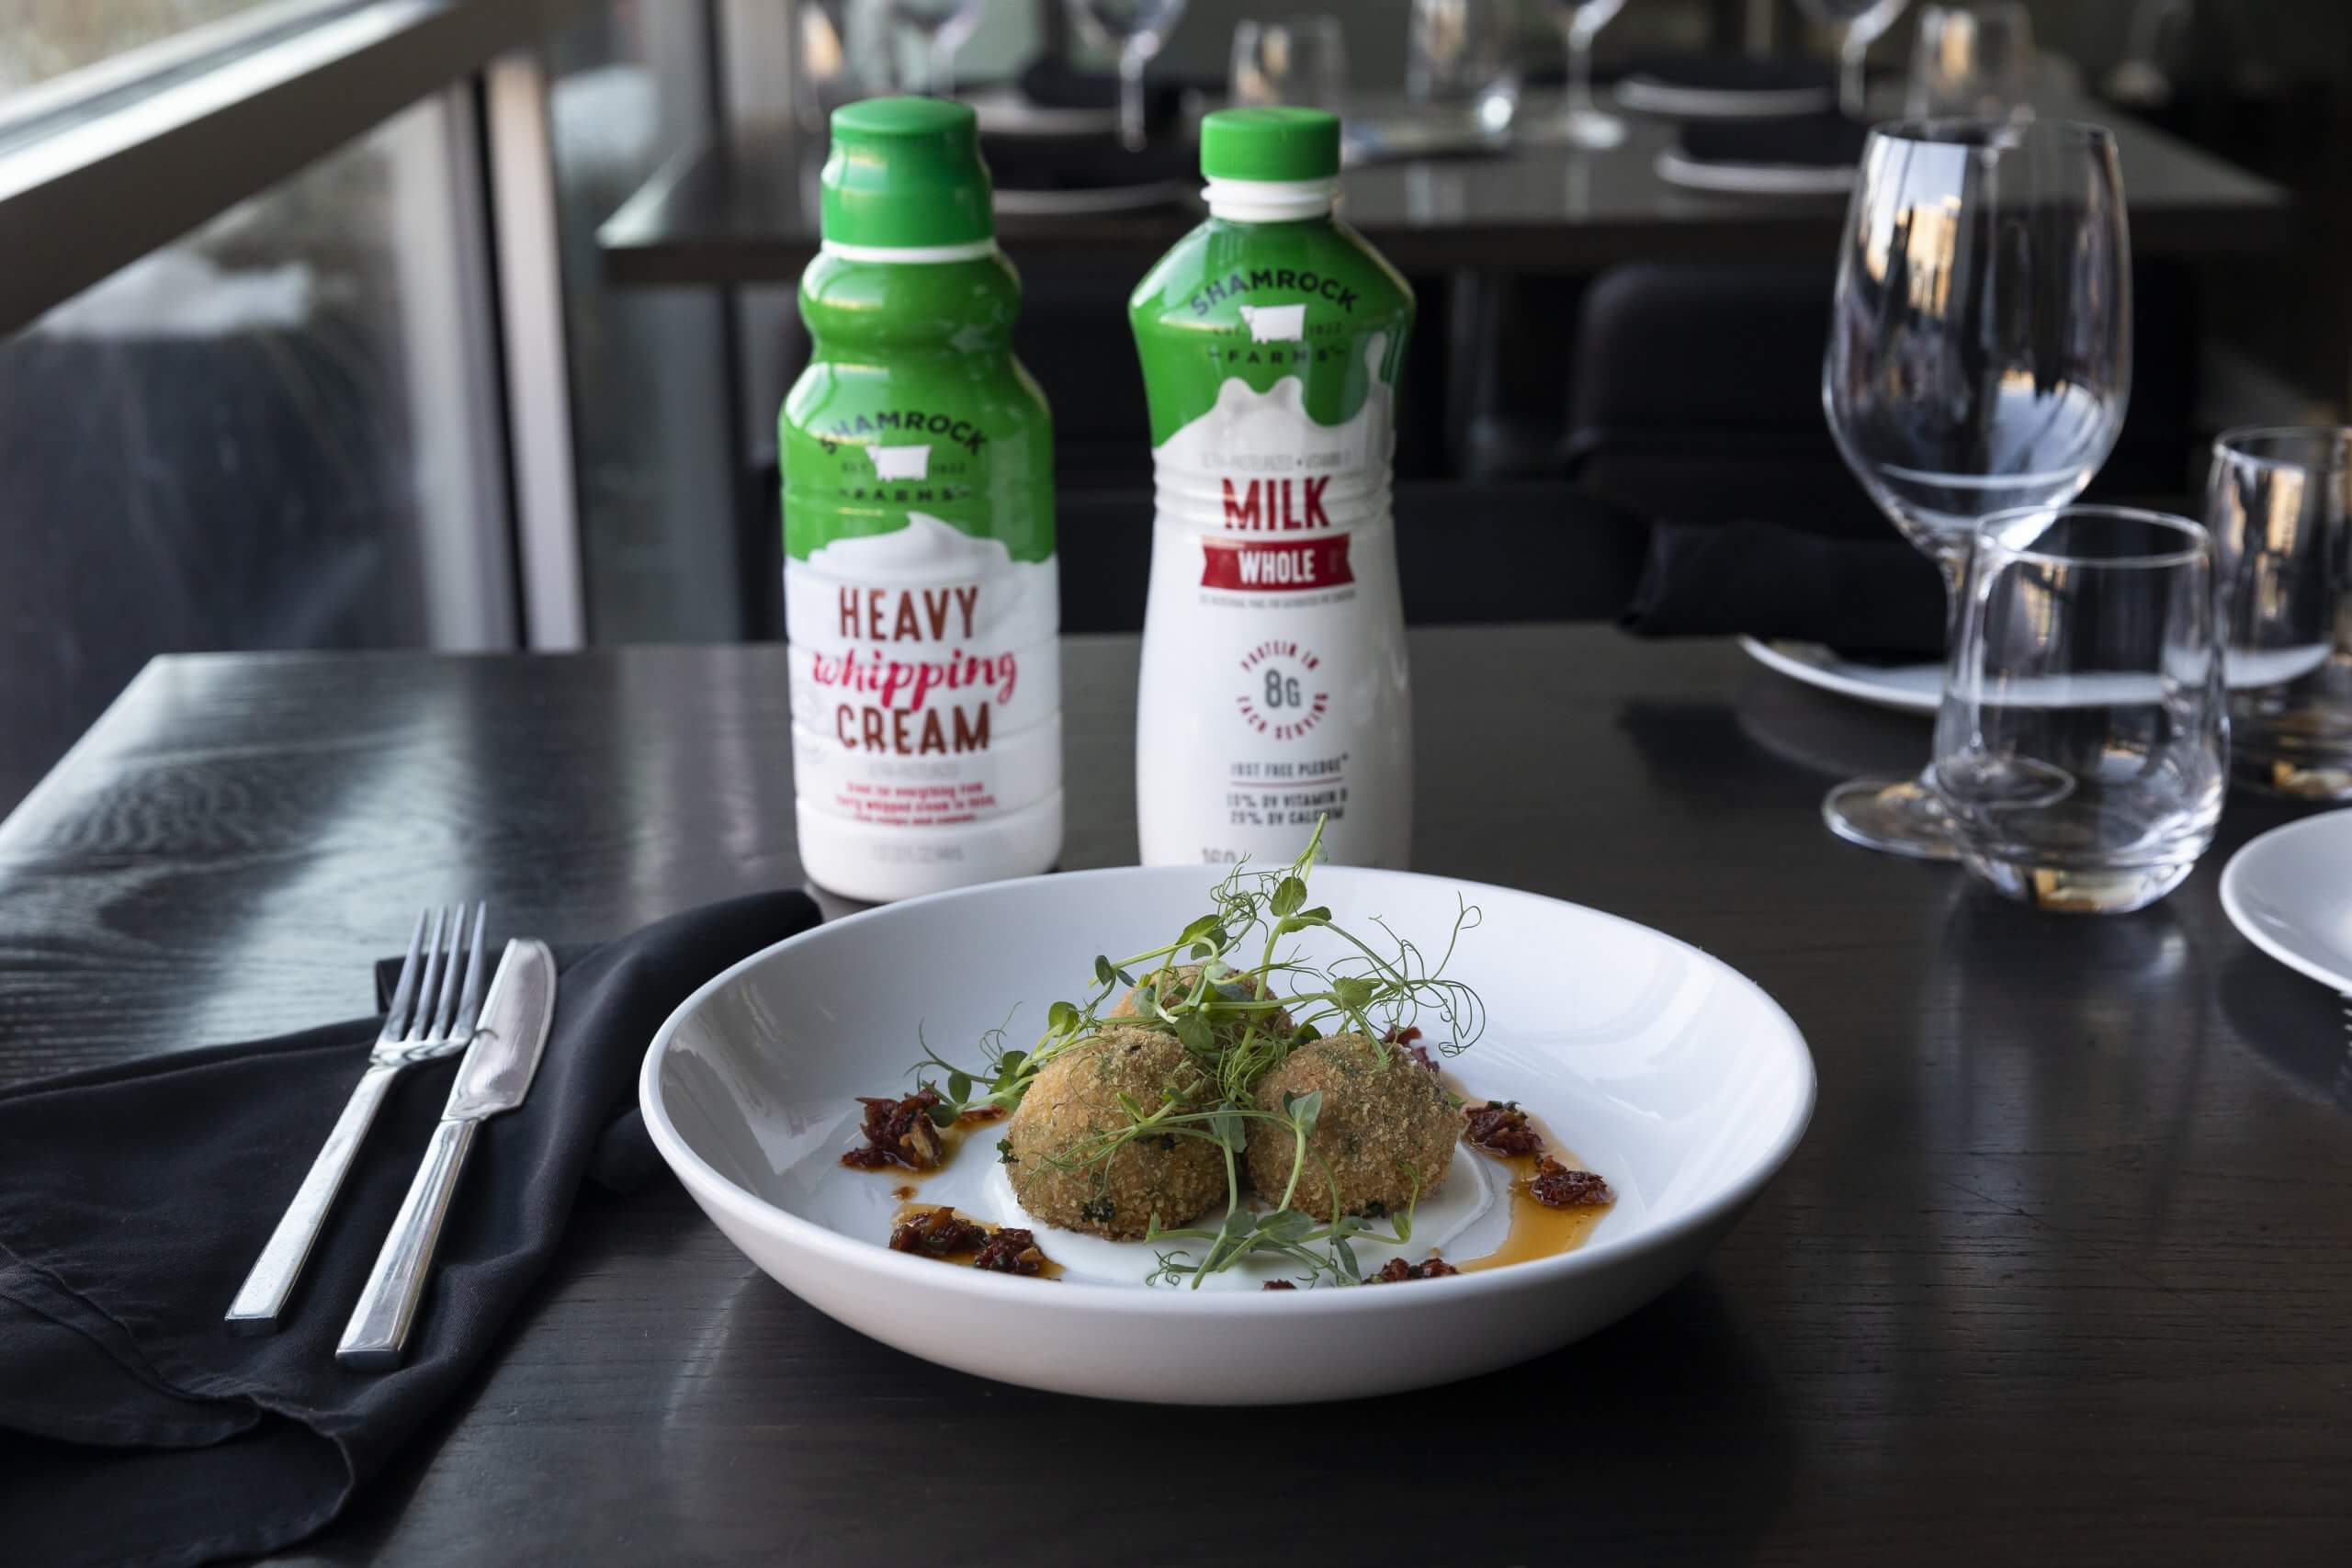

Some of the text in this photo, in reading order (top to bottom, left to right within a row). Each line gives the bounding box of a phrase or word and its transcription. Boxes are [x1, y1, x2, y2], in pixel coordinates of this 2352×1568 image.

[1190, 268, 1359, 316] SHAMROCK
[1227, 349, 1329, 364] FARMS
[819, 412, 989, 456] SHAMROCK
[854, 489, 954, 502] FARMS
[1222, 474, 1332, 530] MILK
[1238, 548, 1317, 584] WHOLE
[840, 586, 978, 641] HEAVY
[1240, 639, 1320, 671] PROTEIN IN
[813, 648, 1017, 712] whipping
[1264, 668, 1302, 708] 8G
[837, 701, 989, 756] CREAM
[1274, 692, 1329, 740] SERVING
[1283, 789, 1336, 807] VITAMIN
